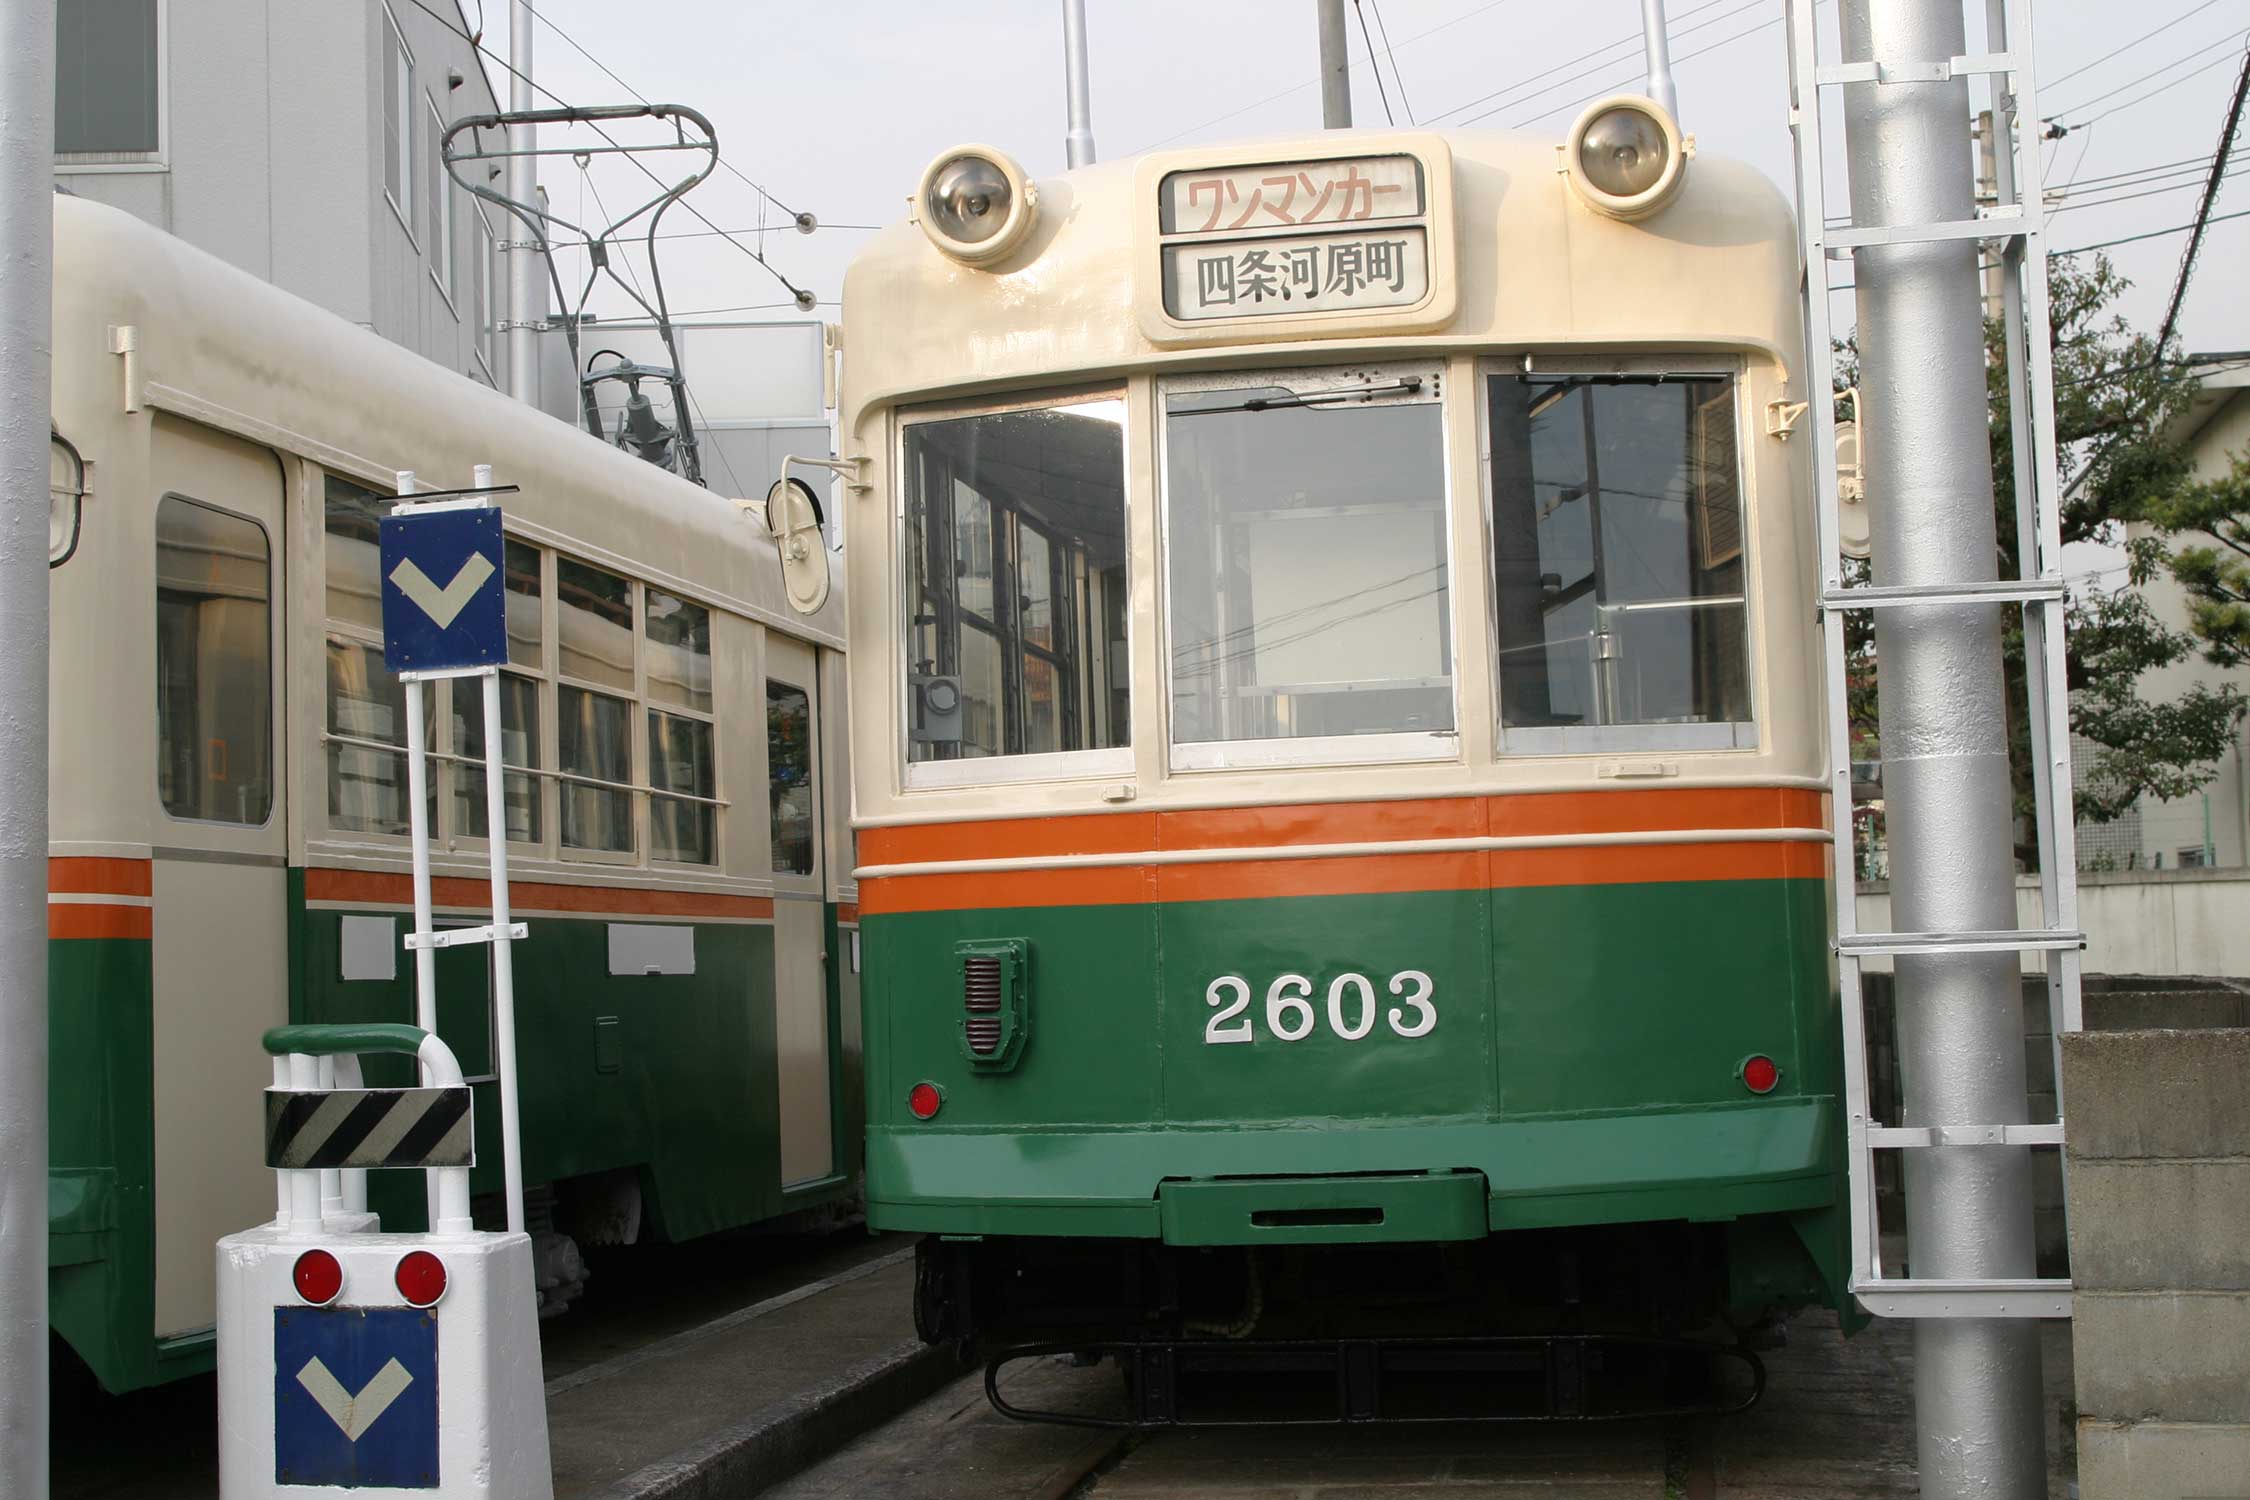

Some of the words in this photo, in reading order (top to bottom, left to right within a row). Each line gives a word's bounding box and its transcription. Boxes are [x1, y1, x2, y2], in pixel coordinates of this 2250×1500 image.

[1188, 166, 1401, 231] ワンマンカー
[1197, 240, 1408, 307] 四条河原町
[1205, 970, 1437, 1044] 2603
